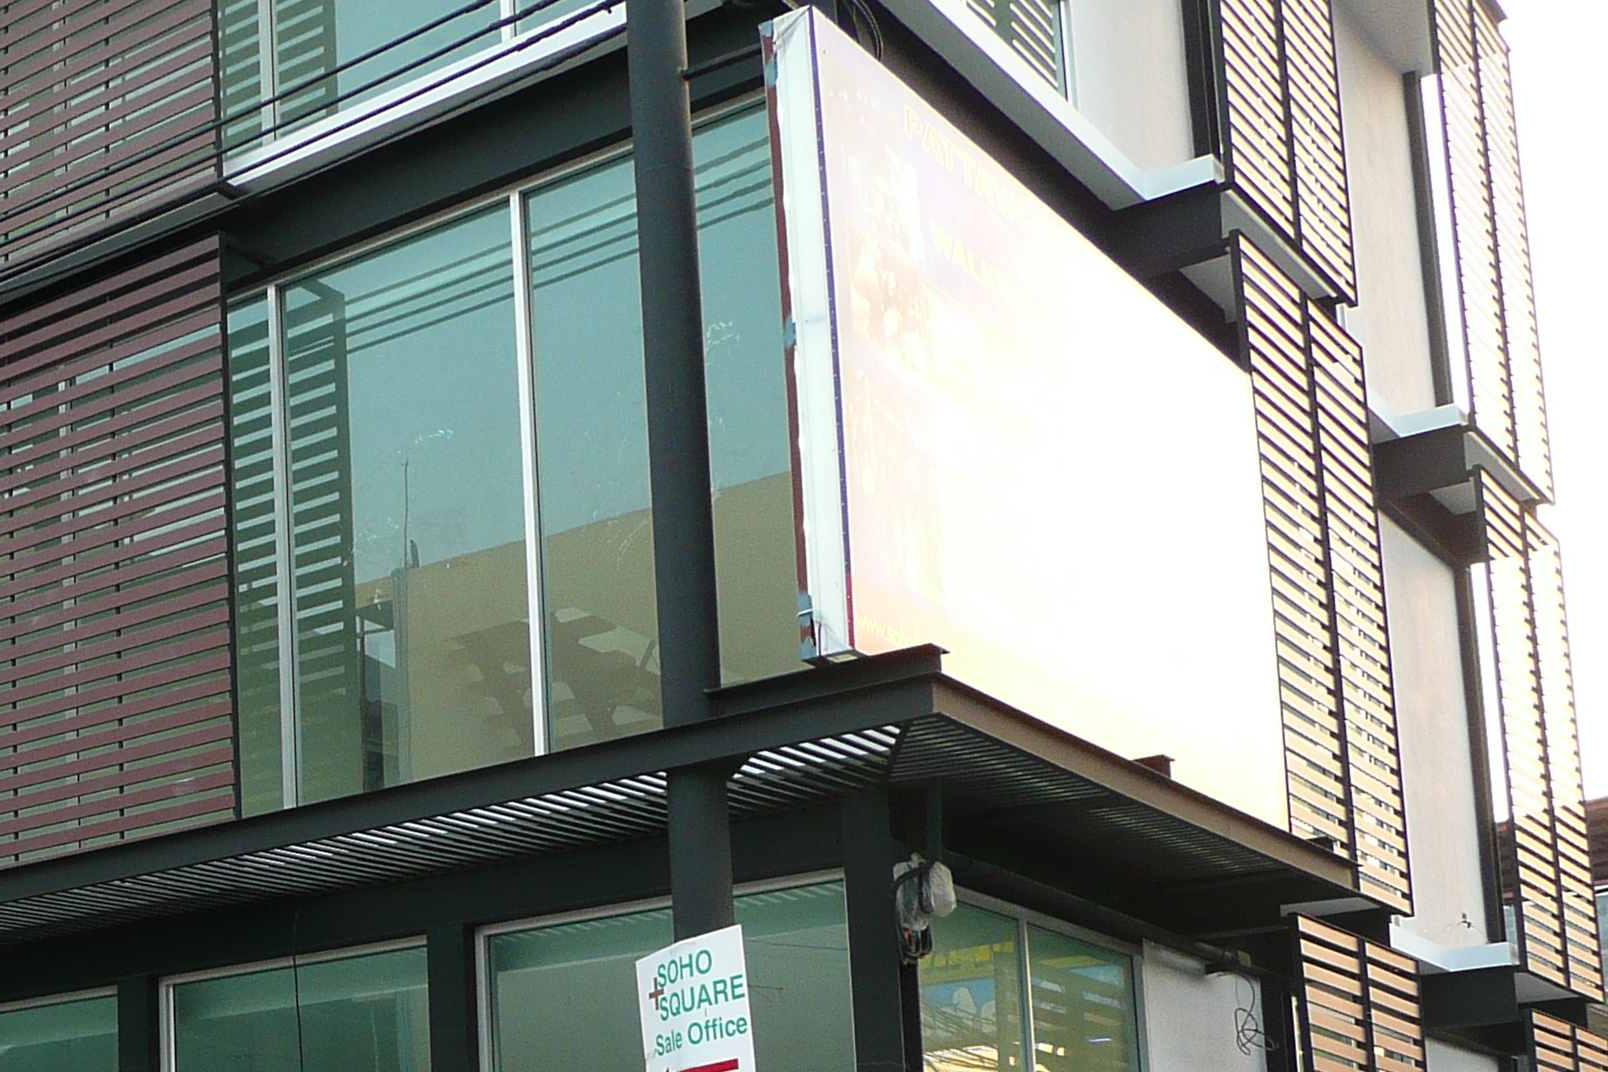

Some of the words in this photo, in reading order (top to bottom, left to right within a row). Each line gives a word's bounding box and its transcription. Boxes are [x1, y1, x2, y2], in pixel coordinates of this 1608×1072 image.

[657, 949, 713, 988] SOHO
[659, 974, 746, 1021] SQUARE
[655, 1030, 683, 1056] Sale
[687, 1016, 748, 1045] Office
